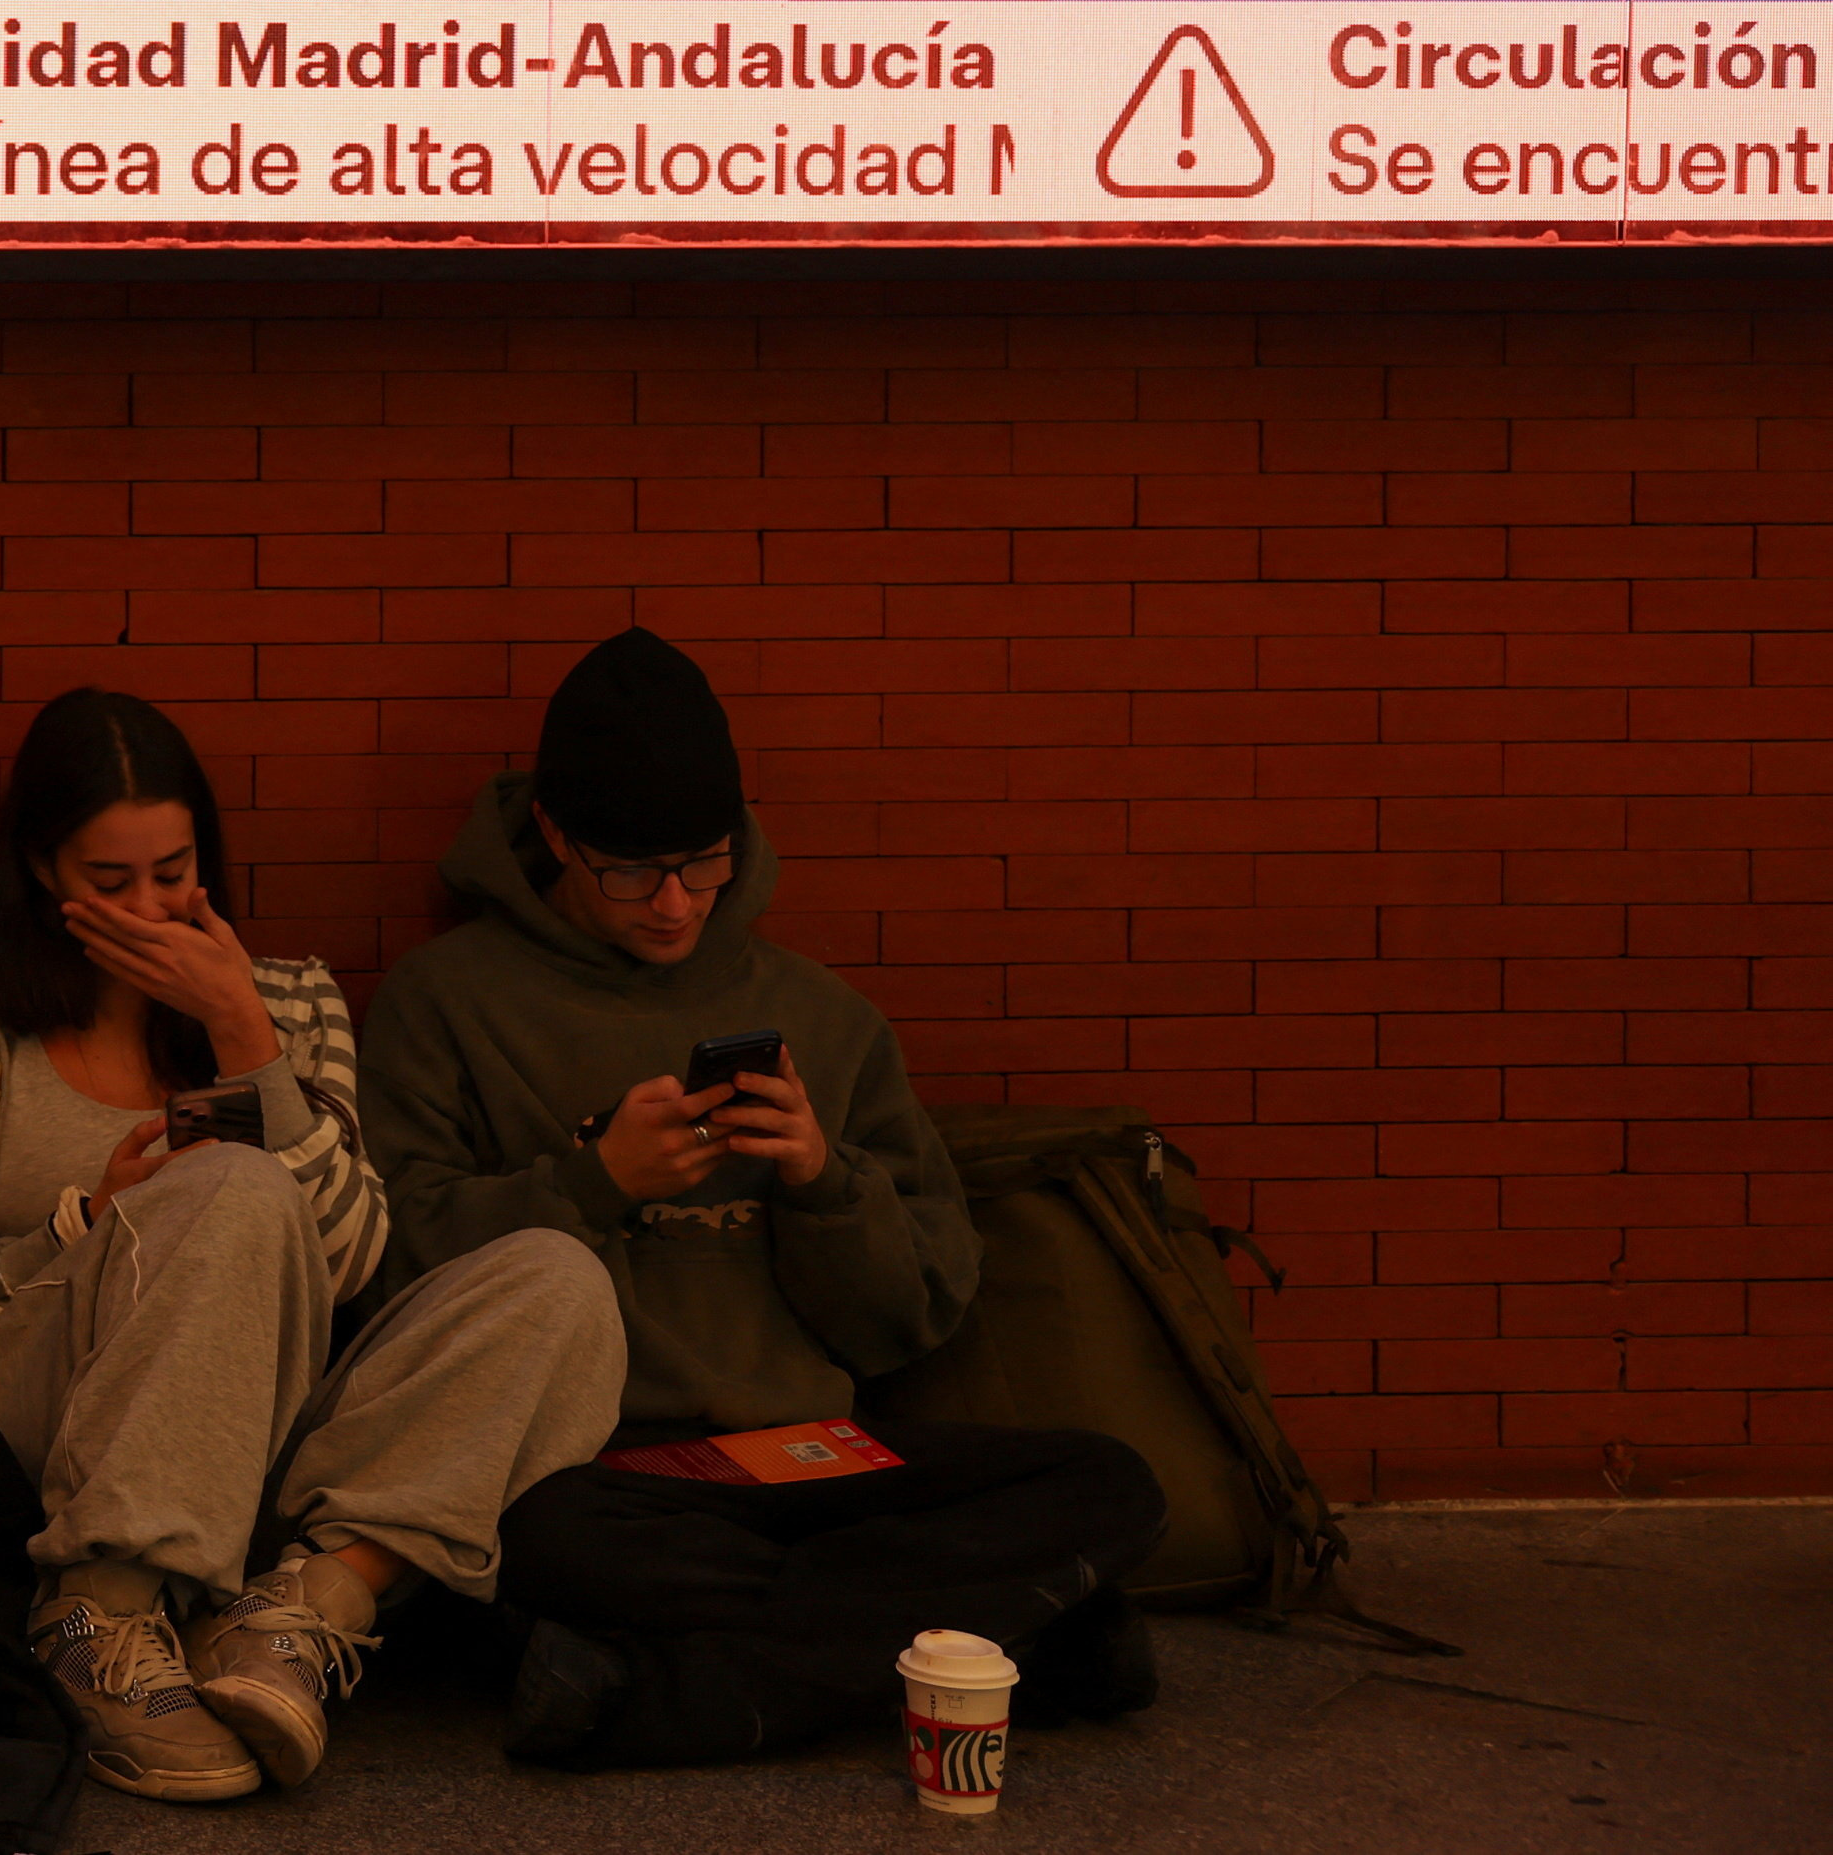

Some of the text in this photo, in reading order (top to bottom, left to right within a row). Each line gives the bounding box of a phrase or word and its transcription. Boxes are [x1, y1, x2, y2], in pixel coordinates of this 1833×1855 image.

[218, 19, 995, 89] Madrid-Andalucía
[1329, 20, 1817, 90] Circulación
[191, 122, 300, 196] de
[329, 123, 493, 196] alta
[523, 123, 956, 196] velocidad
[1328, 124, 1833, 196] Se encuent
